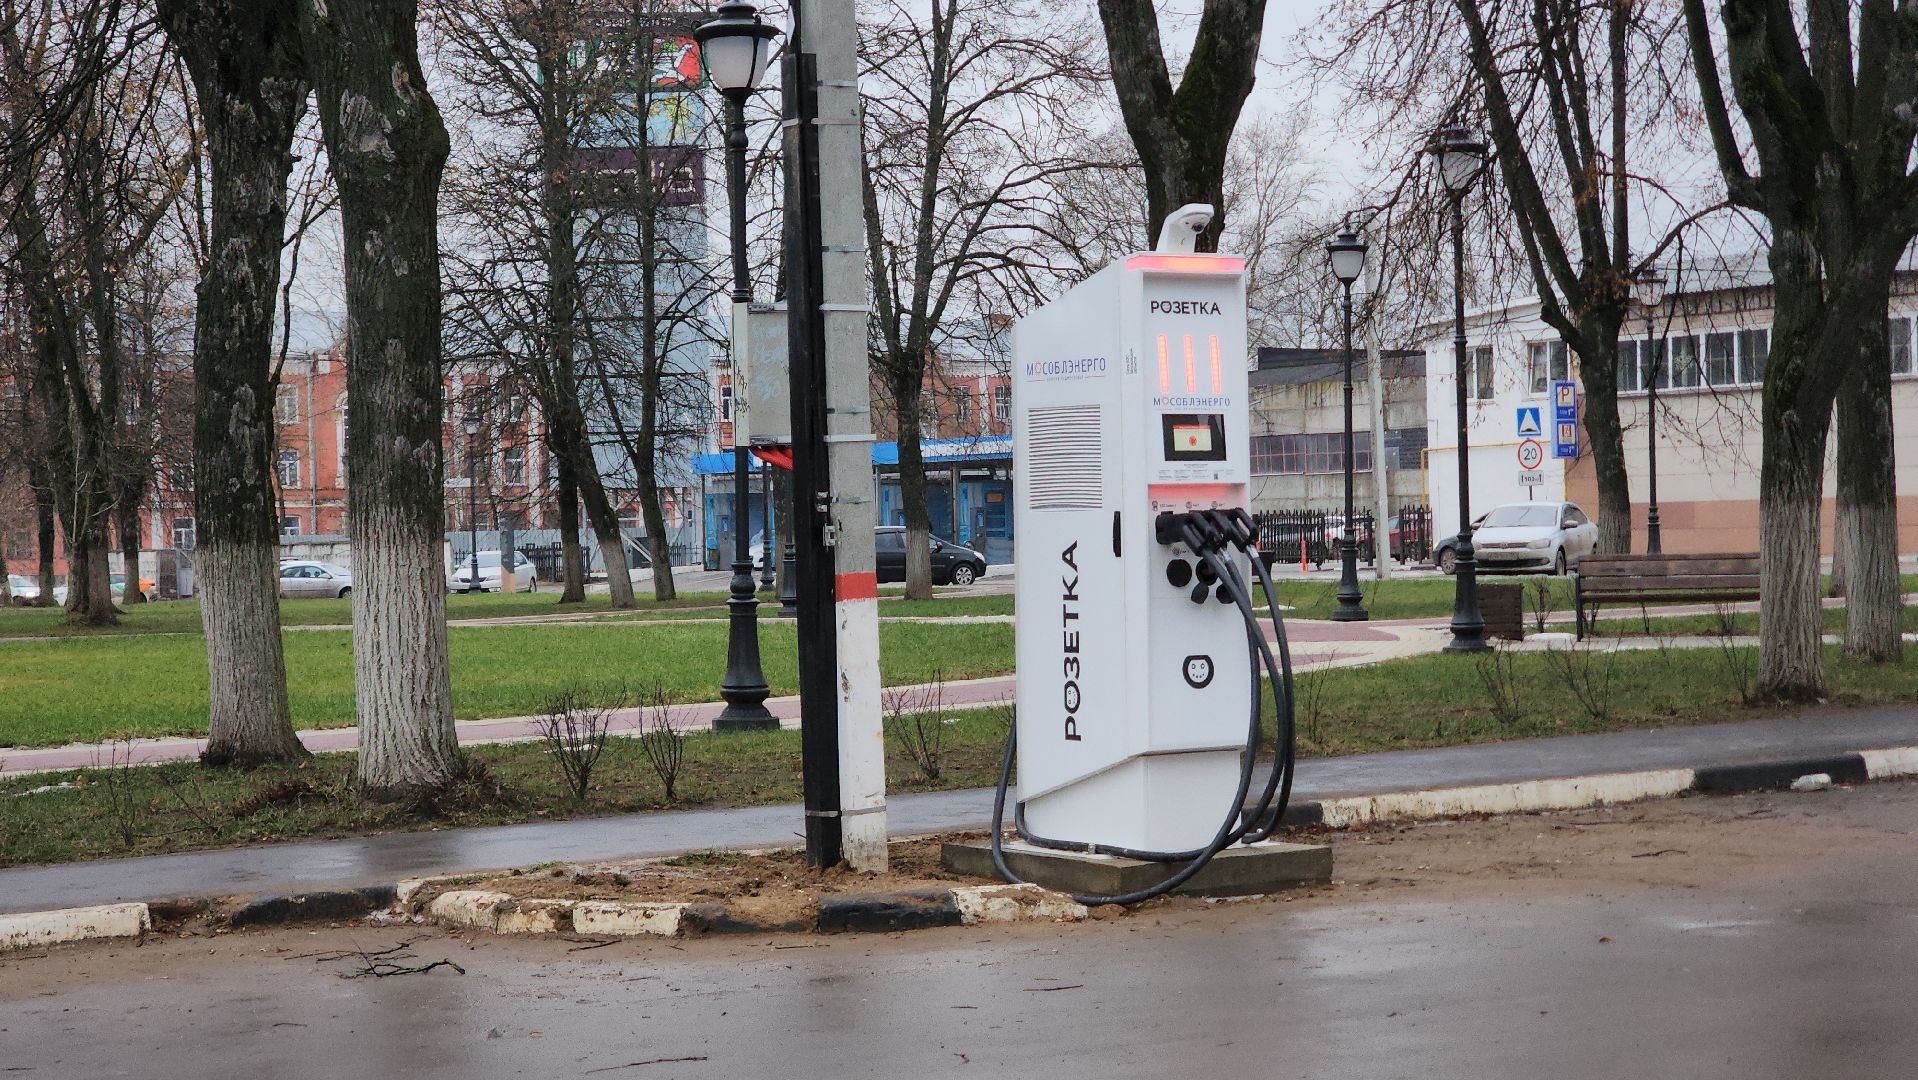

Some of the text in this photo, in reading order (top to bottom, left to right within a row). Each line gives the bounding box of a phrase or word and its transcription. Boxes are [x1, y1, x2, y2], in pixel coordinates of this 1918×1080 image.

[1150, 300, 1222, 315] РОЗЕТКА
[1026, 357, 1106, 376] МОСОБЛЭНЕРГО
[1153, 396, 1231, 407] МОСОБЛЭНЕРГО
[1523, 447, 1538, 461] 20
[1061, 539, 1082, 742] РОЗЕТКА
